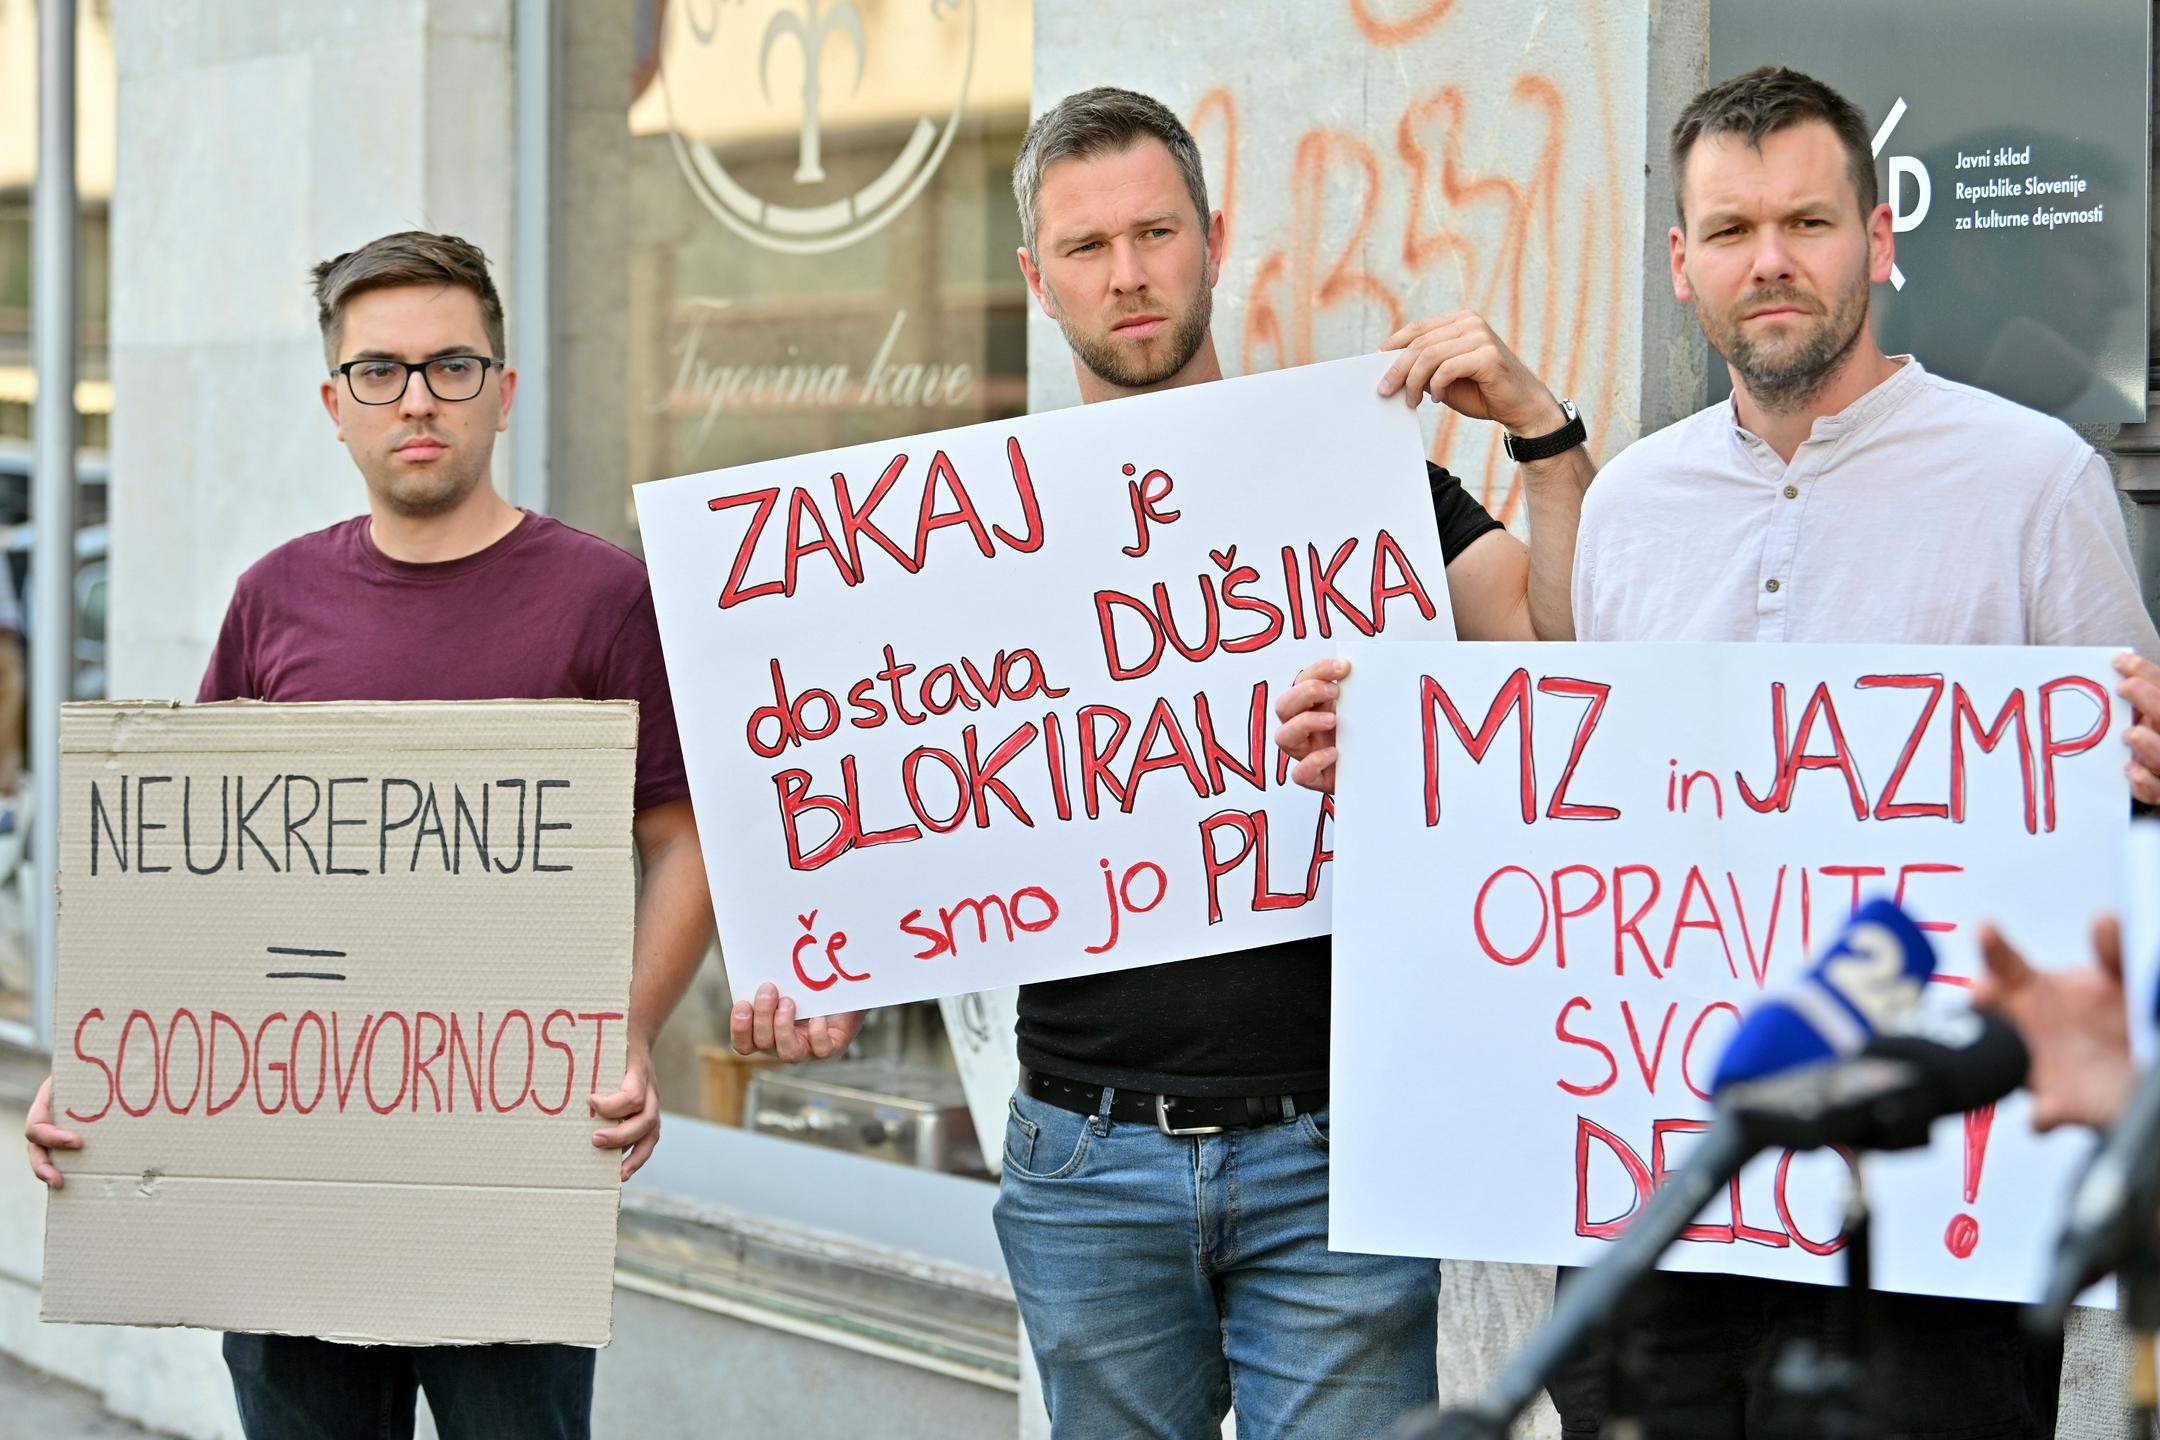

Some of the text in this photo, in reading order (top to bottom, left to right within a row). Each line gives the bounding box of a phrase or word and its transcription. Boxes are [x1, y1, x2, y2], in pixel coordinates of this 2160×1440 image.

[1955, 145, 2031, 170] Javni sklad
[1955, 174, 2087, 204] Republike Slovenije
[1955, 204, 2103, 230] za kulturne dejavnosti
[857, 307, 972, 408] kave
[708, 436, 1181, 610] ZAKAJ je
[746, 528, 1437, 759] dostava DUŠIKA
[1420, 667, 2113, 834] MZ in JAZMP
[91, 774, 573, 877] NEUKREPANJE
[792, 793, 1335, 992] če smo jo PLA
[1473, 863, 1974, 990] OPRAVITE
[66, 1007, 624, 1123] SOODGOVORNOST
[1556, 995, 1742, 1102] SVO
[1575, 1115, 1861, 1257] DELO
